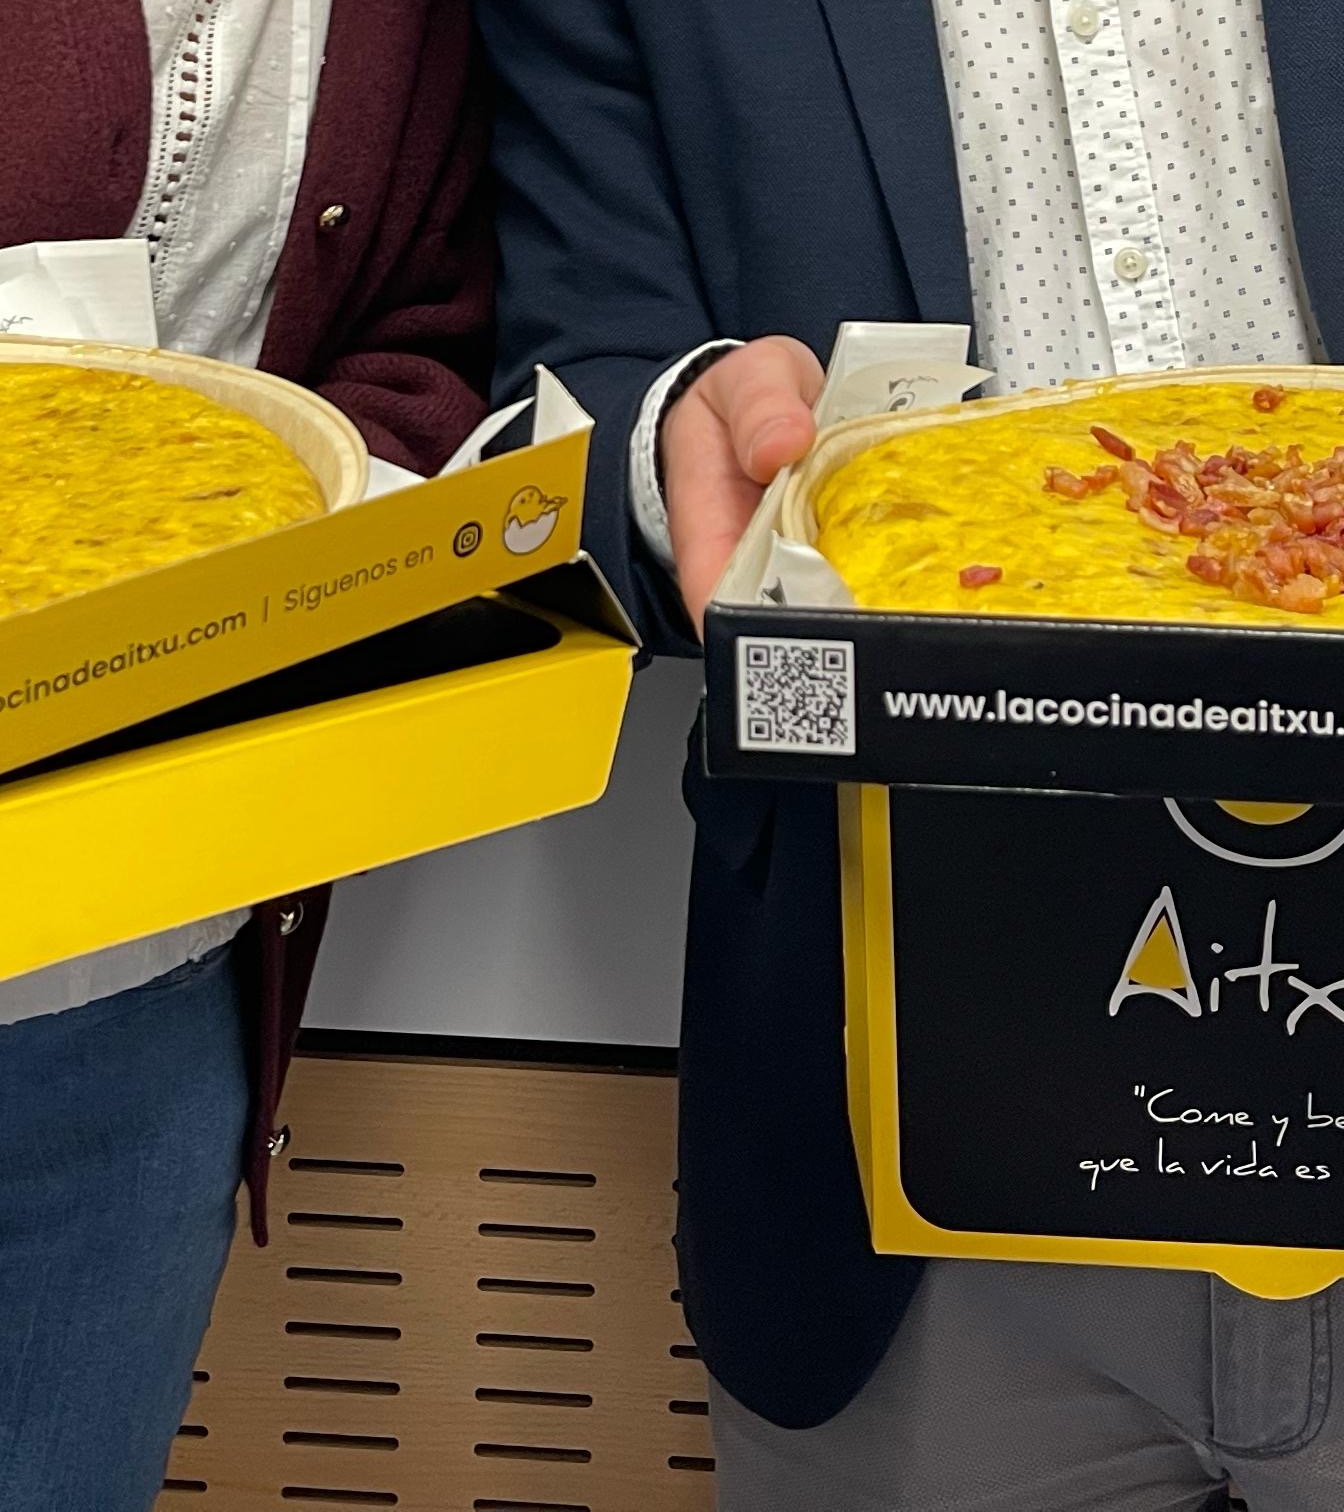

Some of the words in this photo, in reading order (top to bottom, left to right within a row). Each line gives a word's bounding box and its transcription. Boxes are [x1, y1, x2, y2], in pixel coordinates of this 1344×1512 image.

[283, 558, 398, 613] Síguenos
[404, 543, 435, 569] en
[1133, 1084, 1255, 1126] "Come
[1271, 1113, 1290, 1147] y
[1078, 1156, 1140, 1191] que
[1157, 1136, 1186, 1175] la
[1200, 1139, 1279, 1179] vida
[1294, 1163, 1331, 1180] es
